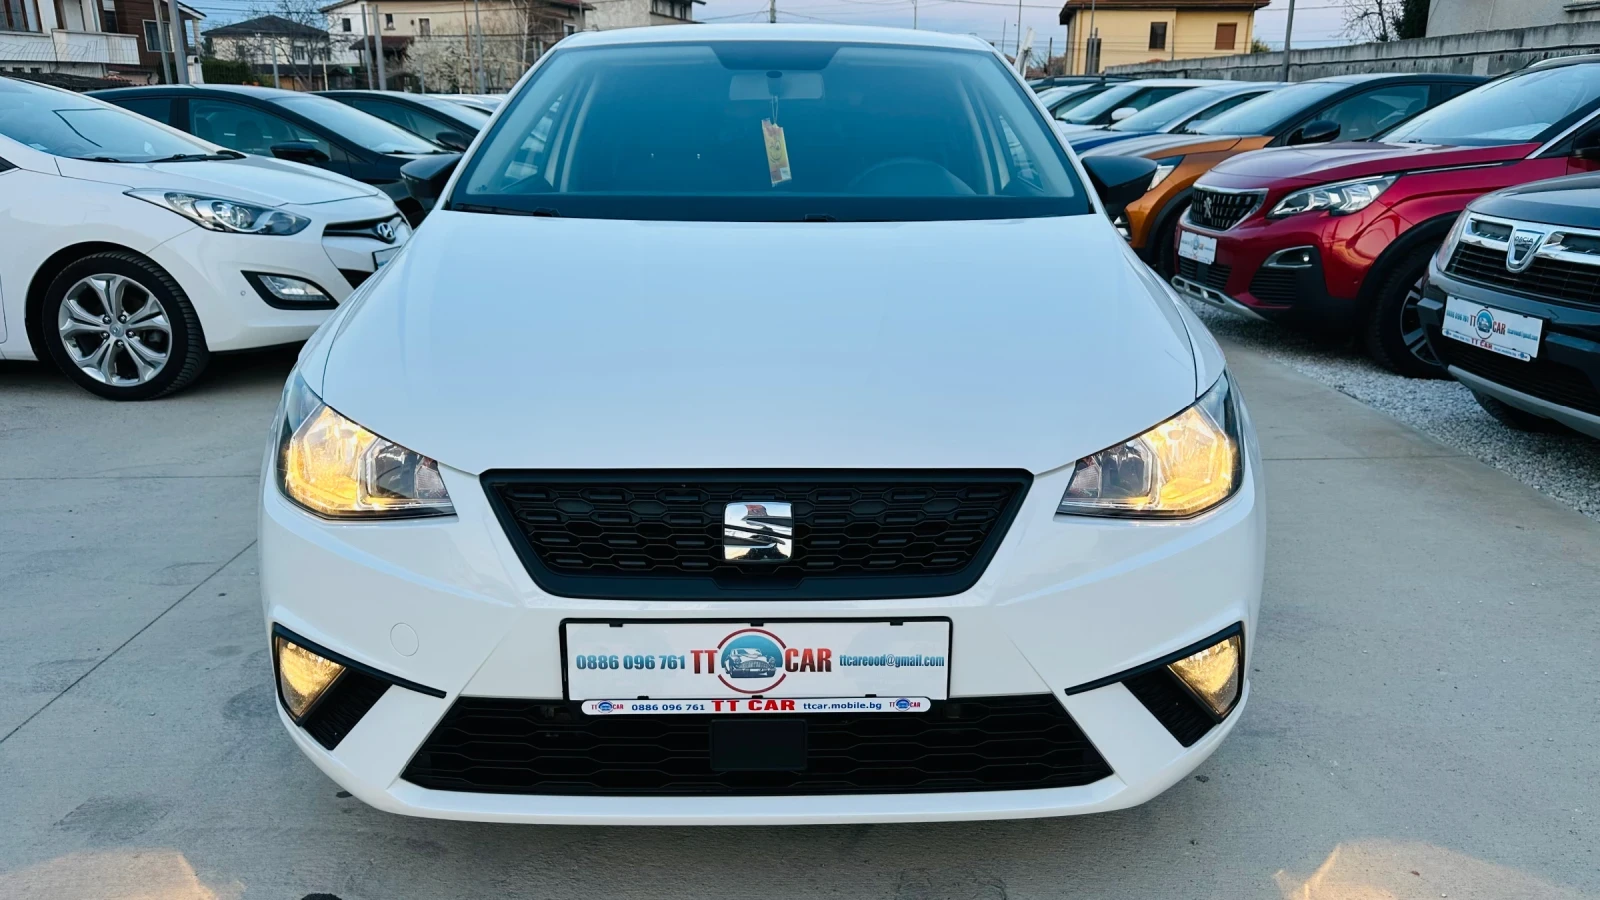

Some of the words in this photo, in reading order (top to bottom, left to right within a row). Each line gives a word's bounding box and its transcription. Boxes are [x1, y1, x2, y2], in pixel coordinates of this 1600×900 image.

[1469, 314, 1477, 327] TT
[1493, 321, 1506, 335] CAR
[1480, 339, 1493, 349] CAR
[576, 654, 619, 670] 0886
[623, 654, 655, 670] 096
[659, 654, 686, 670] 761
[690, 649, 718, 674] TT
[784, 648, 832, 673] CAR
[839, 653, 945, 668] ttcareood@gmail.com
[631, 703, 659, 711] 0886
[662, 703, 682, 711] 096
[686, 703, 705, 711] 761
[711, 700, 740, 712] TT
[748, 700, 796, 711] CAR
[803, 701, 882, 711] ttcar.mobile.bg
